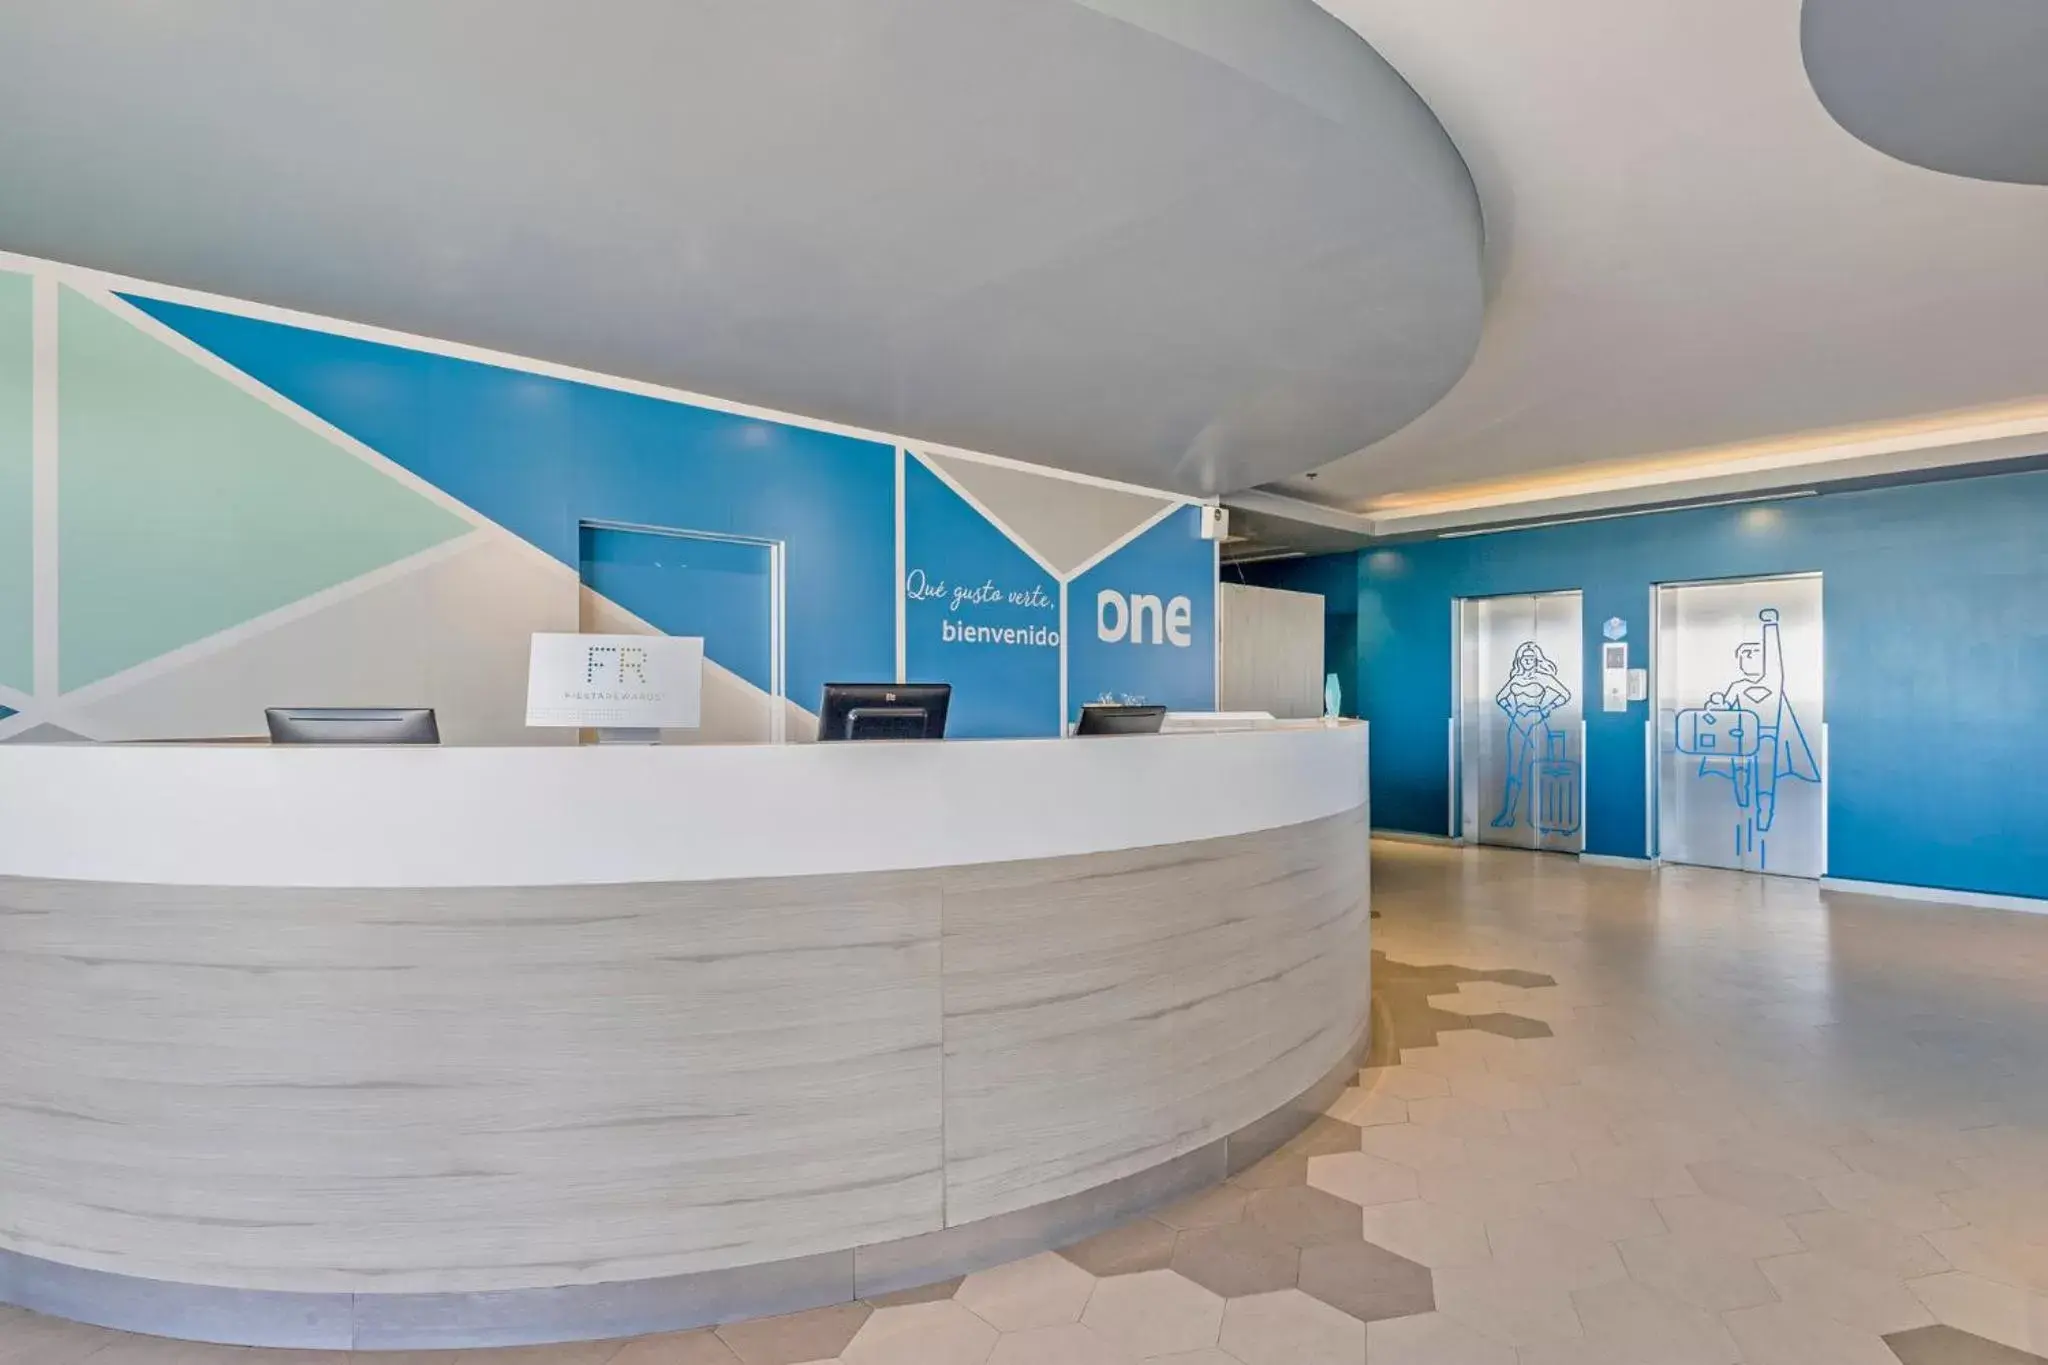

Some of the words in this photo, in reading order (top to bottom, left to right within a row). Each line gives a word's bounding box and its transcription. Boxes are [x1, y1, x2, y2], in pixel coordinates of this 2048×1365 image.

[907, 569, 948, 600] Qué
[951, 579, 1003, 611] gusto
[1008, 585, 1055, 610] verte,
[942, 619, 1059, 646] bienvenido
[1097, 588, 1191, 647] one
[587, 646, 647, 684] FR
